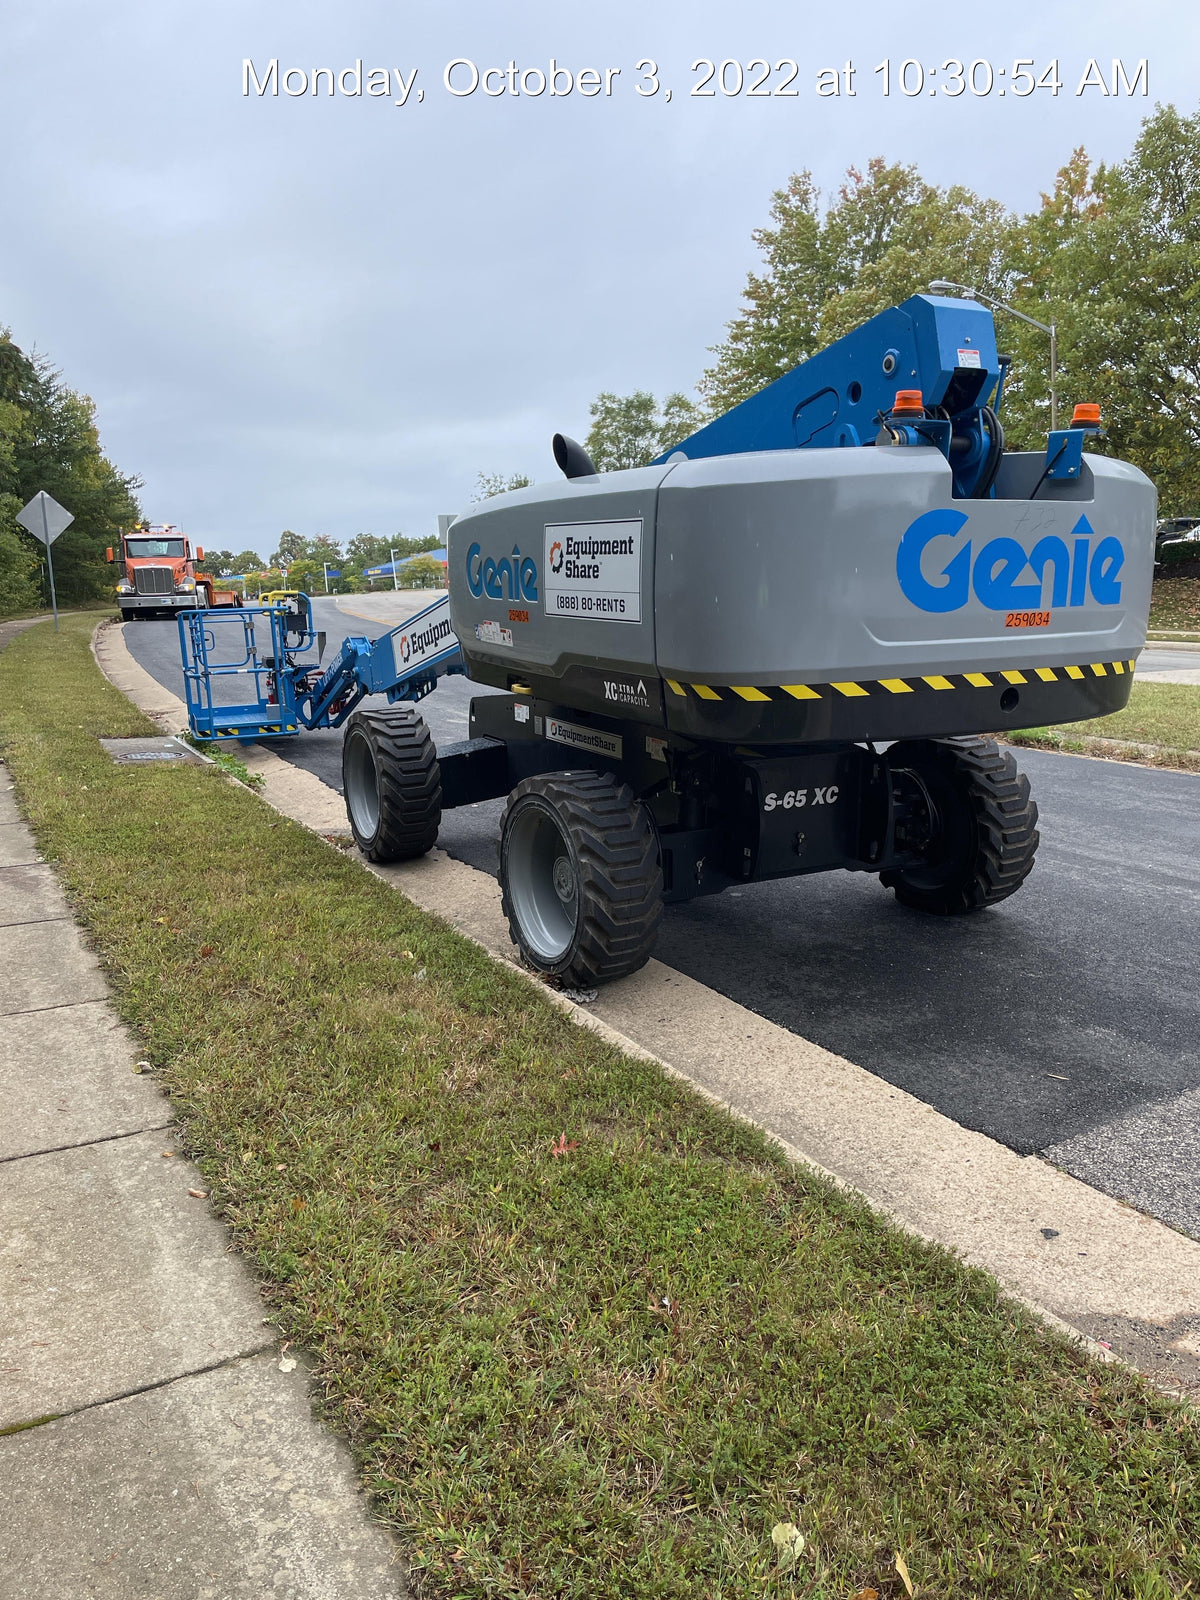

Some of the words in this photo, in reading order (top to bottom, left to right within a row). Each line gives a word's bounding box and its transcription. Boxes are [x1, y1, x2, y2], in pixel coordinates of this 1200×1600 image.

[565, 535, 635, 560] Equipment
[896, 508, 1125, 613] Genie
[466, 542, 538, 603] Genie
[556, 594, 579, 611] (888)
[581, 597, 626, 613] 80-RENTS
[1005, 611, 1051, 628] 259034
[410, 618, 453, 655] Equipm
[603, 680, 618, 701] XC
[619, 683, 635, 695] XTRA
[557, 725, 617, 752] EquipmentShare
[763, 789, 808, 812] S-65
[811, 785, 839, 806] XC
